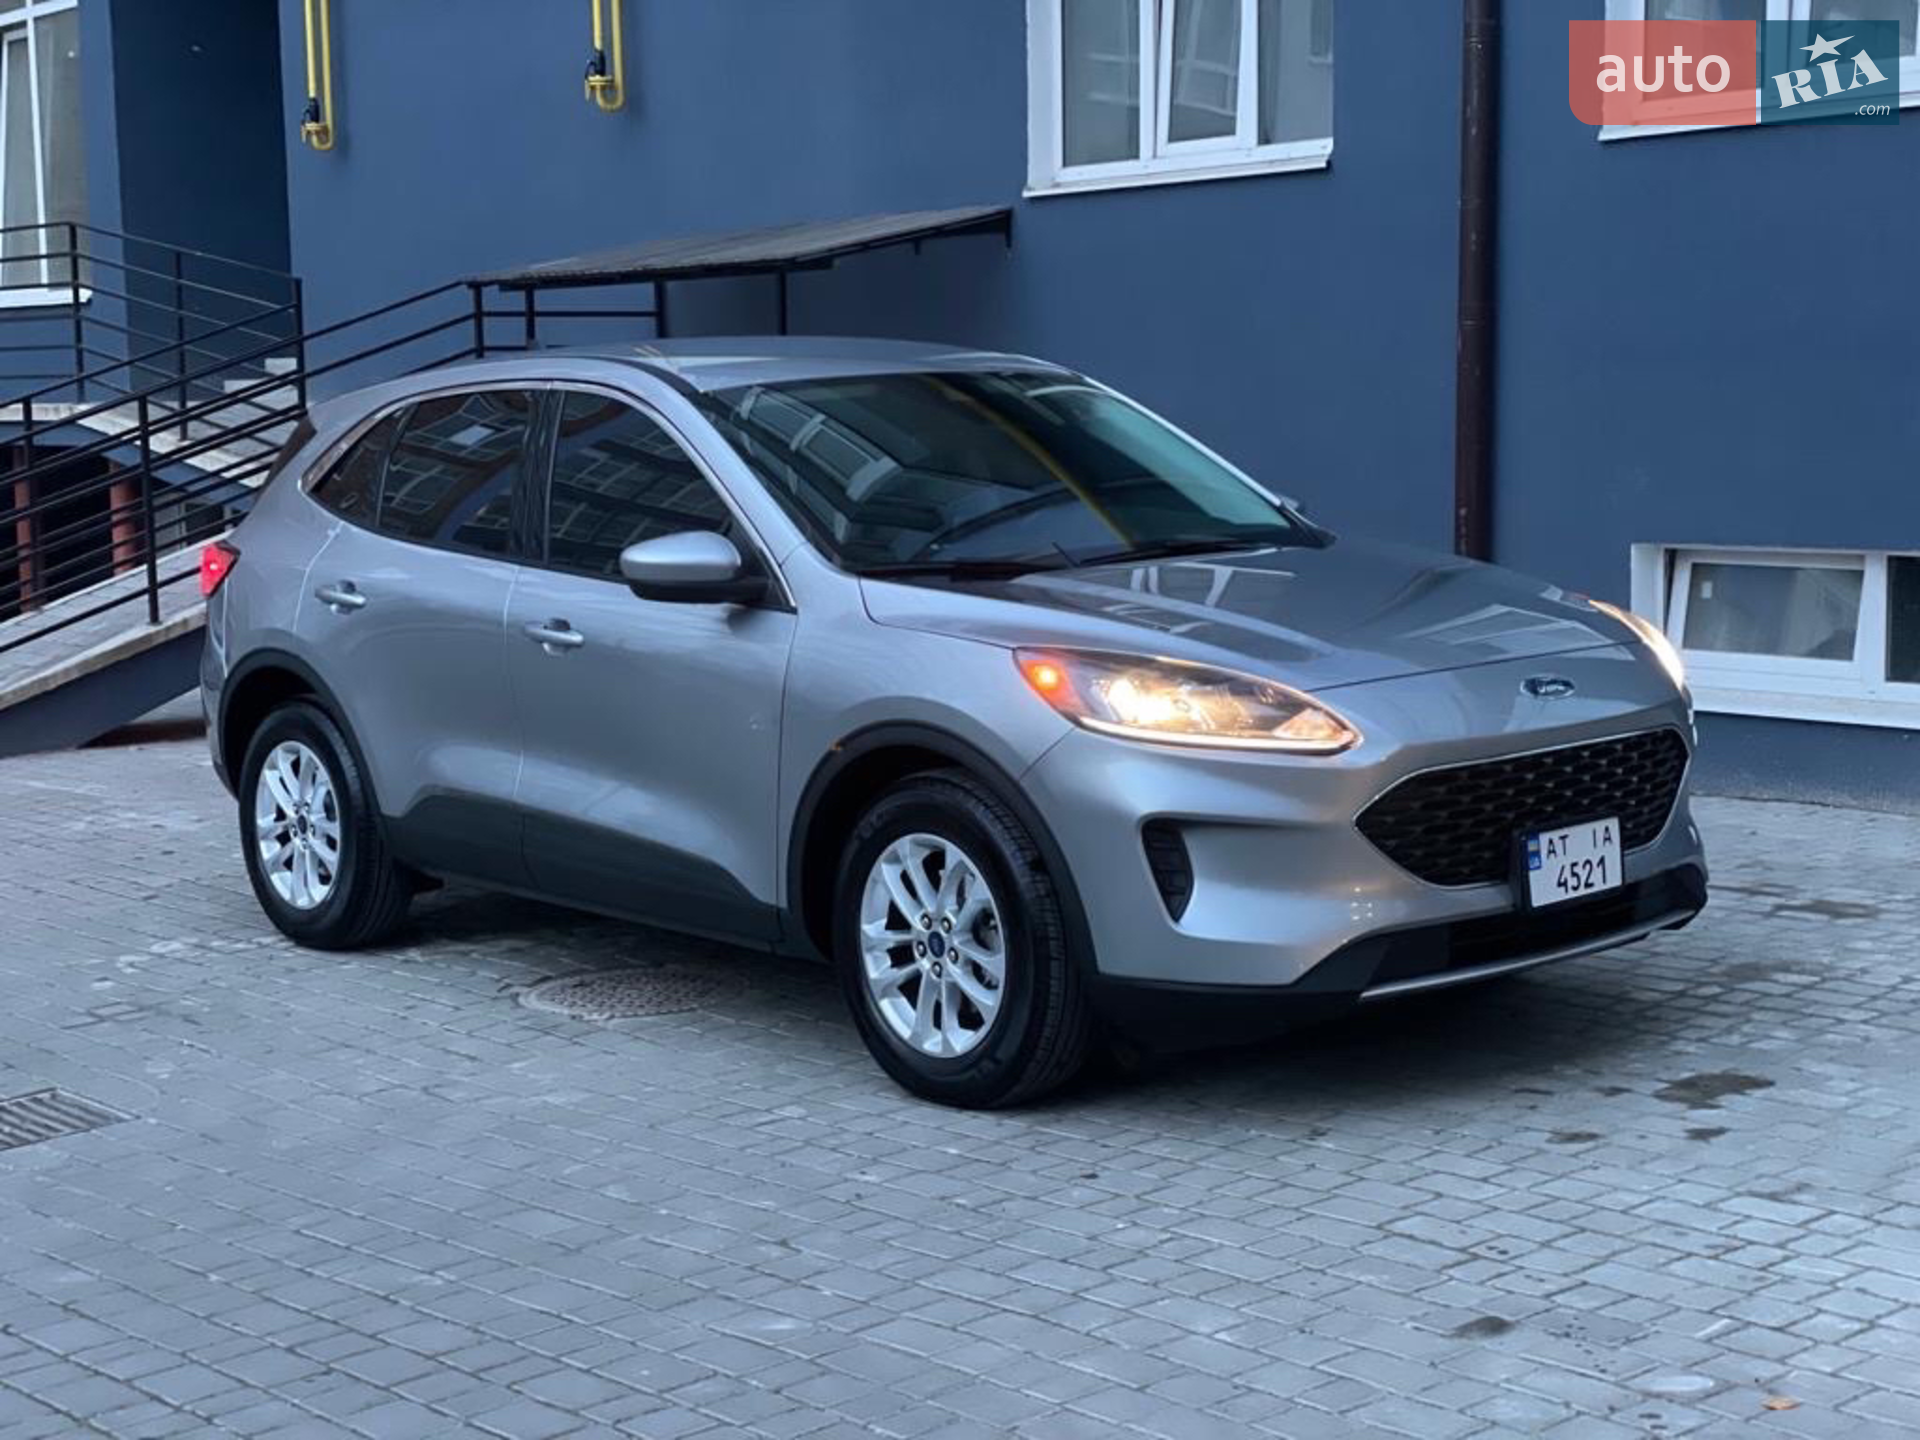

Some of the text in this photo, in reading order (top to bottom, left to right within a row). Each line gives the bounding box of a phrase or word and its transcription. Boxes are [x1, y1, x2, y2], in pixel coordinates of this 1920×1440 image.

[1546, 825, 1613, 860] AT IA
[1556, 854, 1607, 894] 4521
